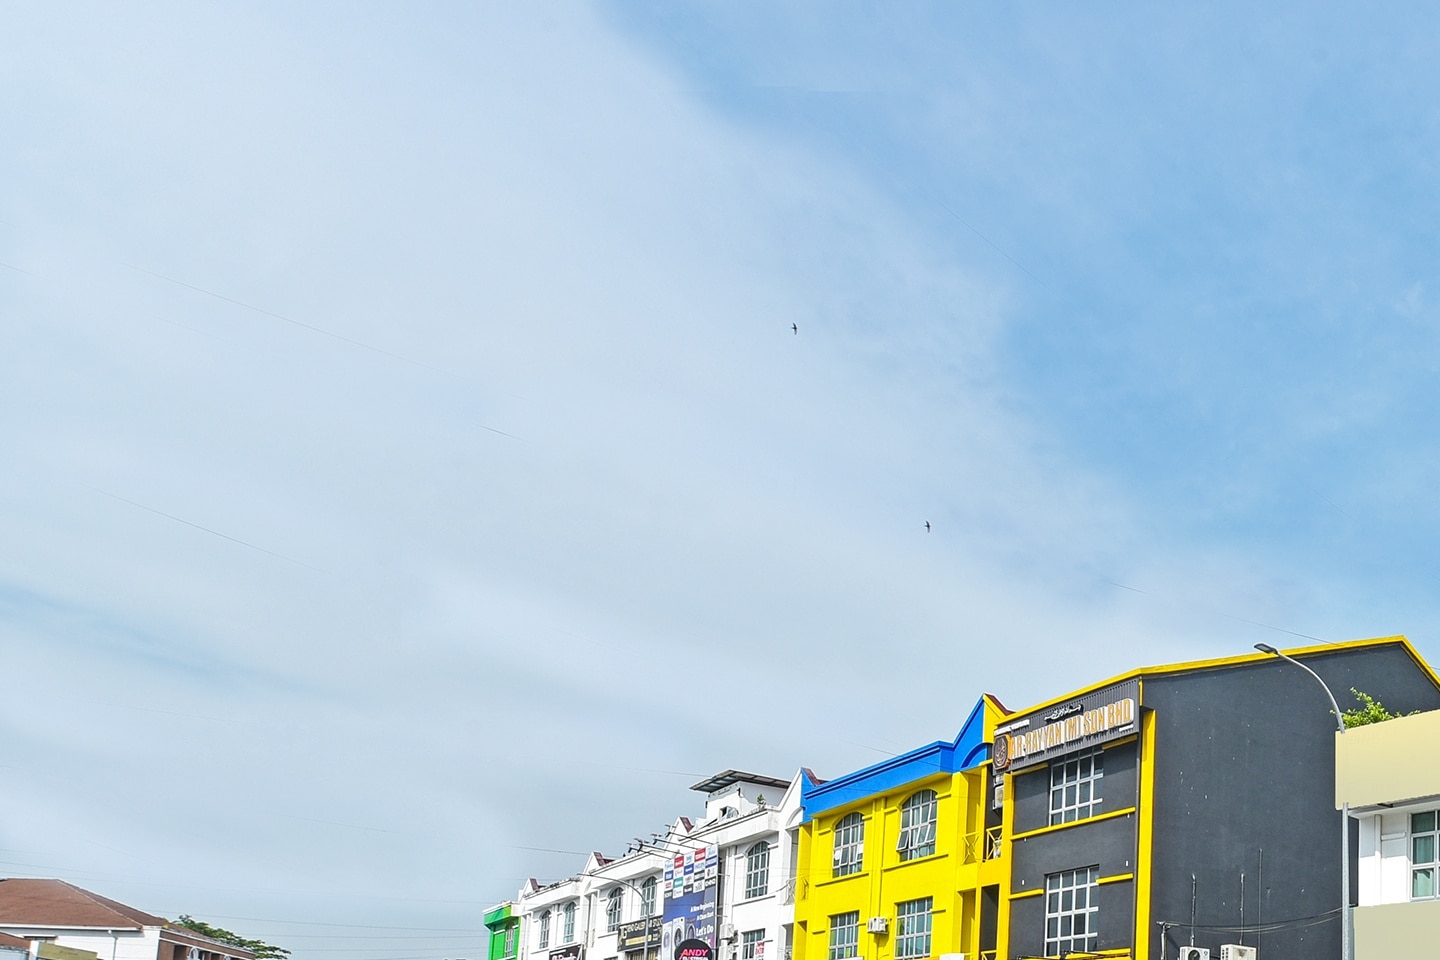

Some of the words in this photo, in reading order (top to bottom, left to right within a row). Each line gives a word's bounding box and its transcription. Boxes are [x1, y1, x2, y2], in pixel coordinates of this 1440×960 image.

[1083, 705, 1109, 736] SDN
[1107, 697, 1135, 729] BHD
[680, 948, 709, 958] ANDY
